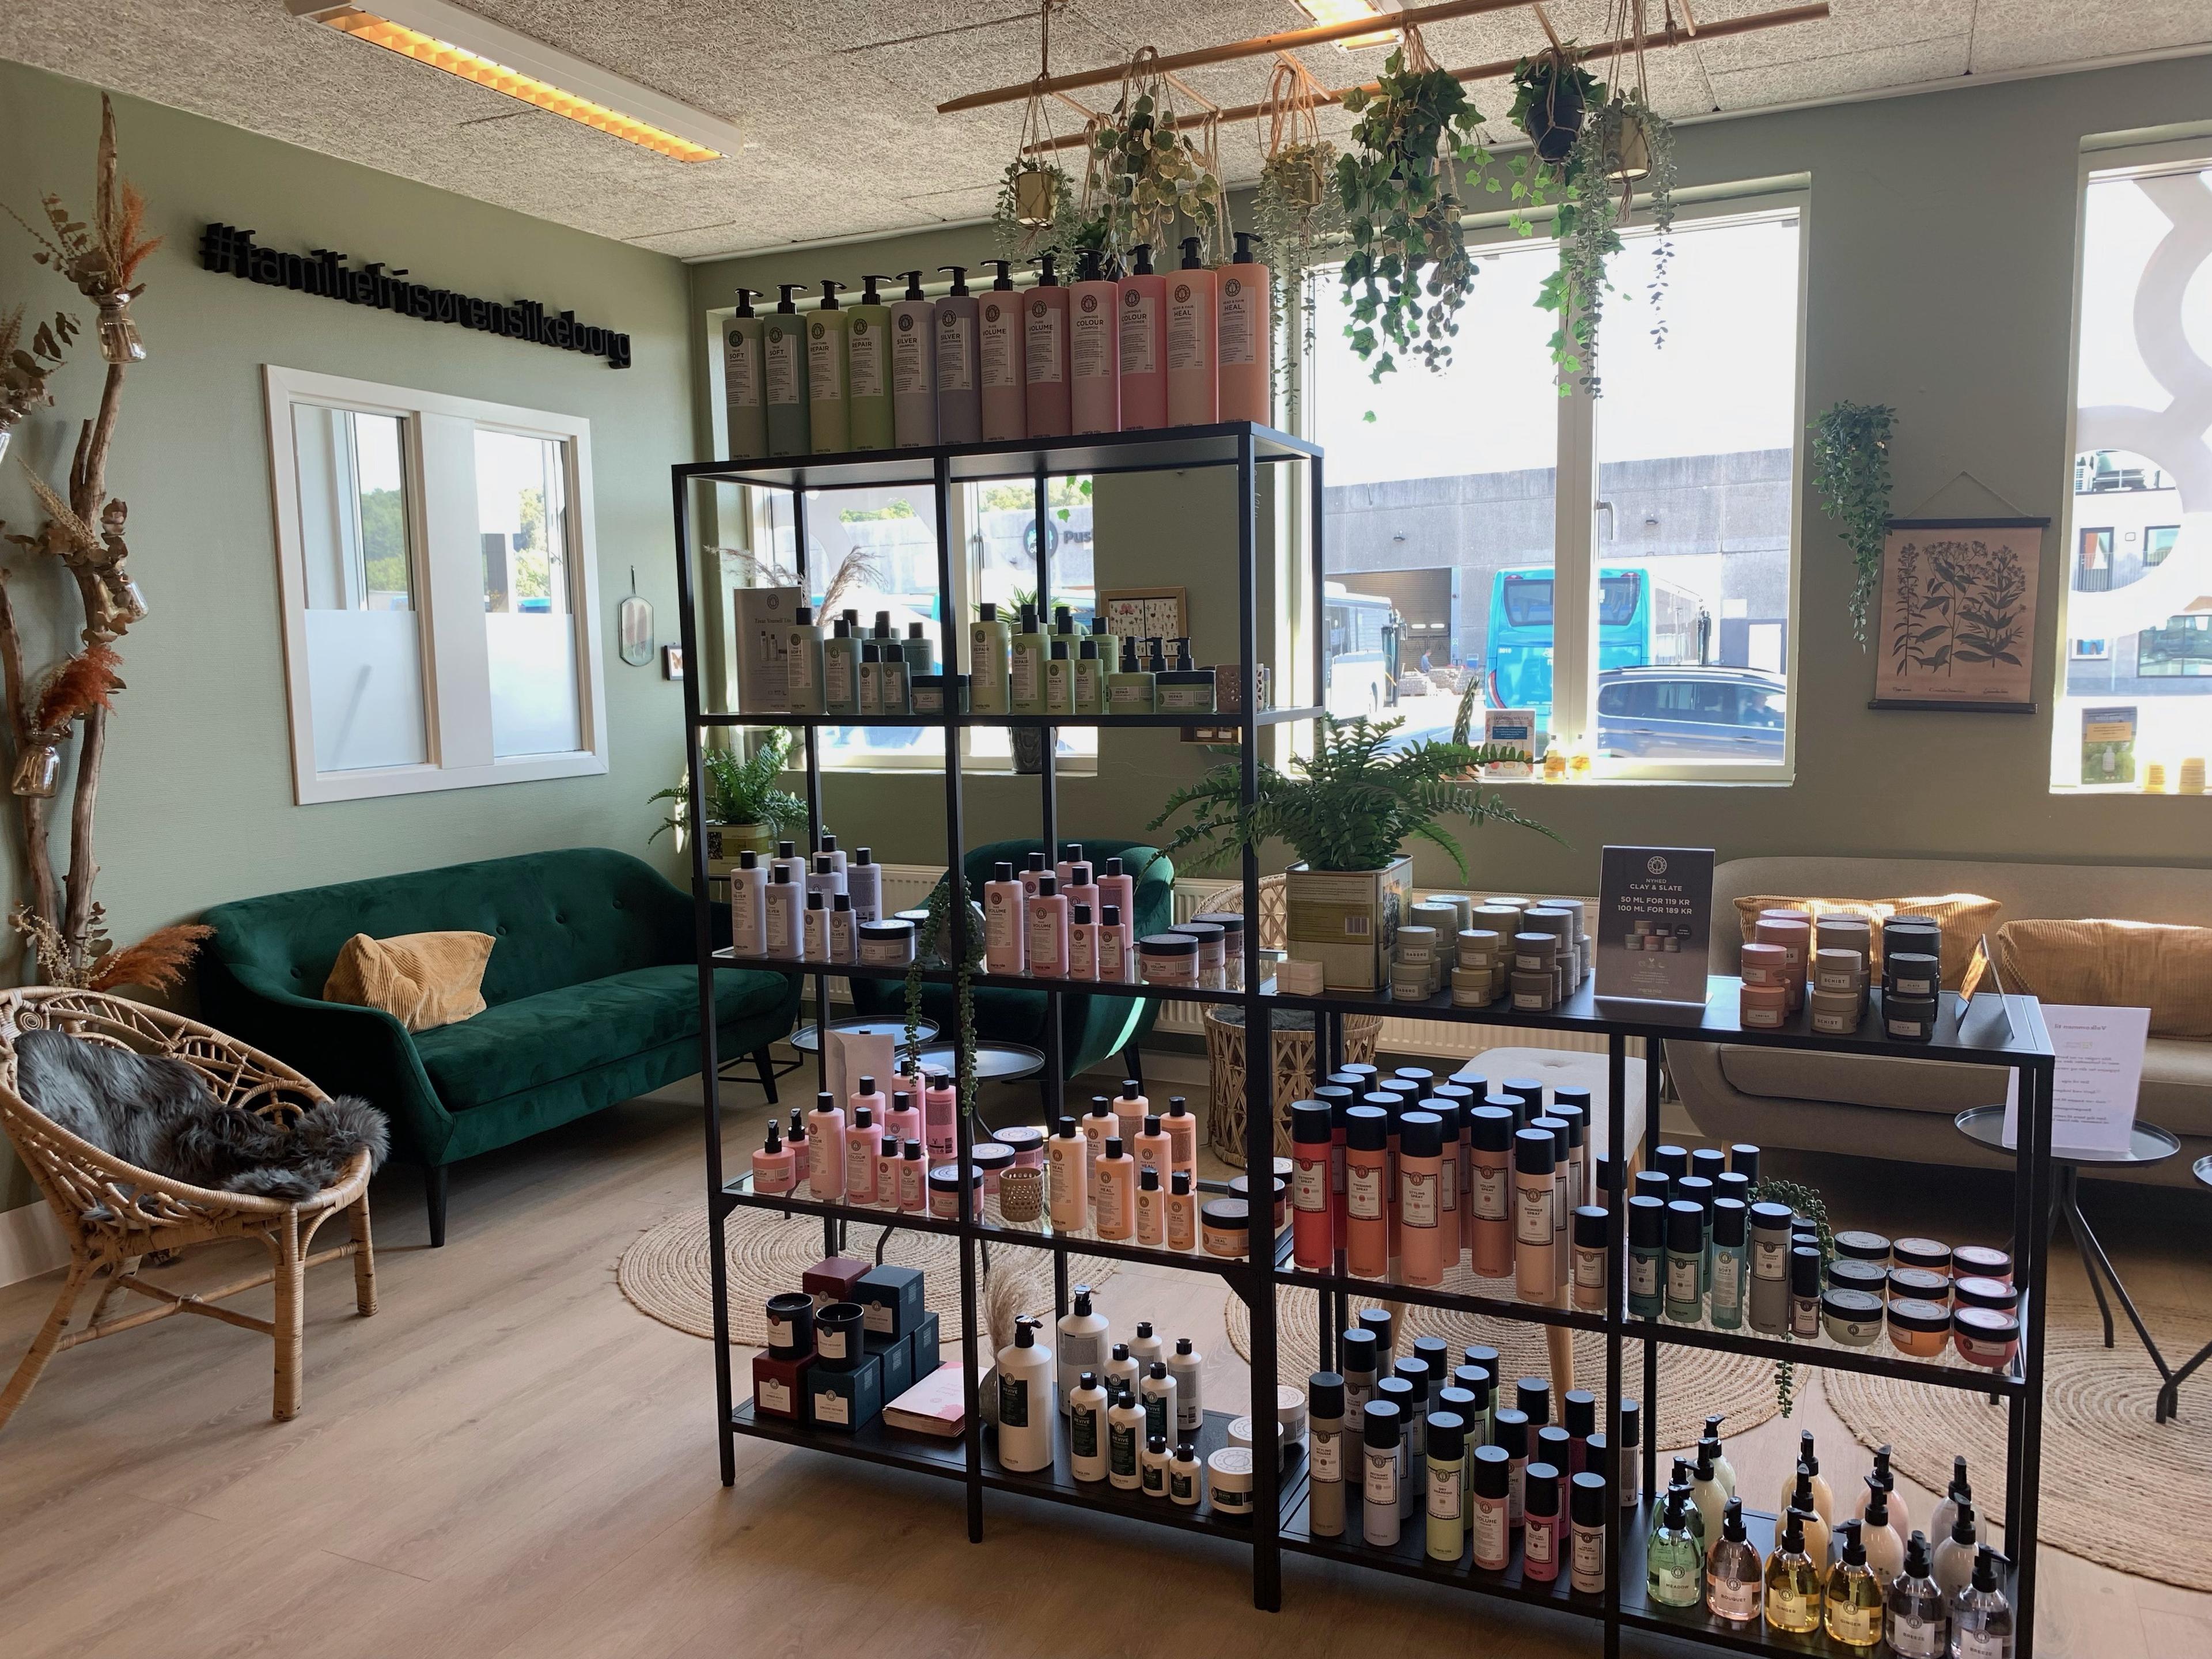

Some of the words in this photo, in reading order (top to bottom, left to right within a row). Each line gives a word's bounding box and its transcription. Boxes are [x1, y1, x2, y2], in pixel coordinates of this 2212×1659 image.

[1121, 313, 1147, 322] COLOUR
[1063, 531, 1093, 544] Pus
[1476, 1516, 1497, 1524] VOLUME
[1721, 1594, 1746, 1602] BOUQUET
[1776, 1604, 1796, 1613] GINGER
[1840, 1619, 1861, 1627] GINGER
[1903, 1632, 1925, 1641] BREEZE
[1970, 1647, 1993, 1656] BREEZE
